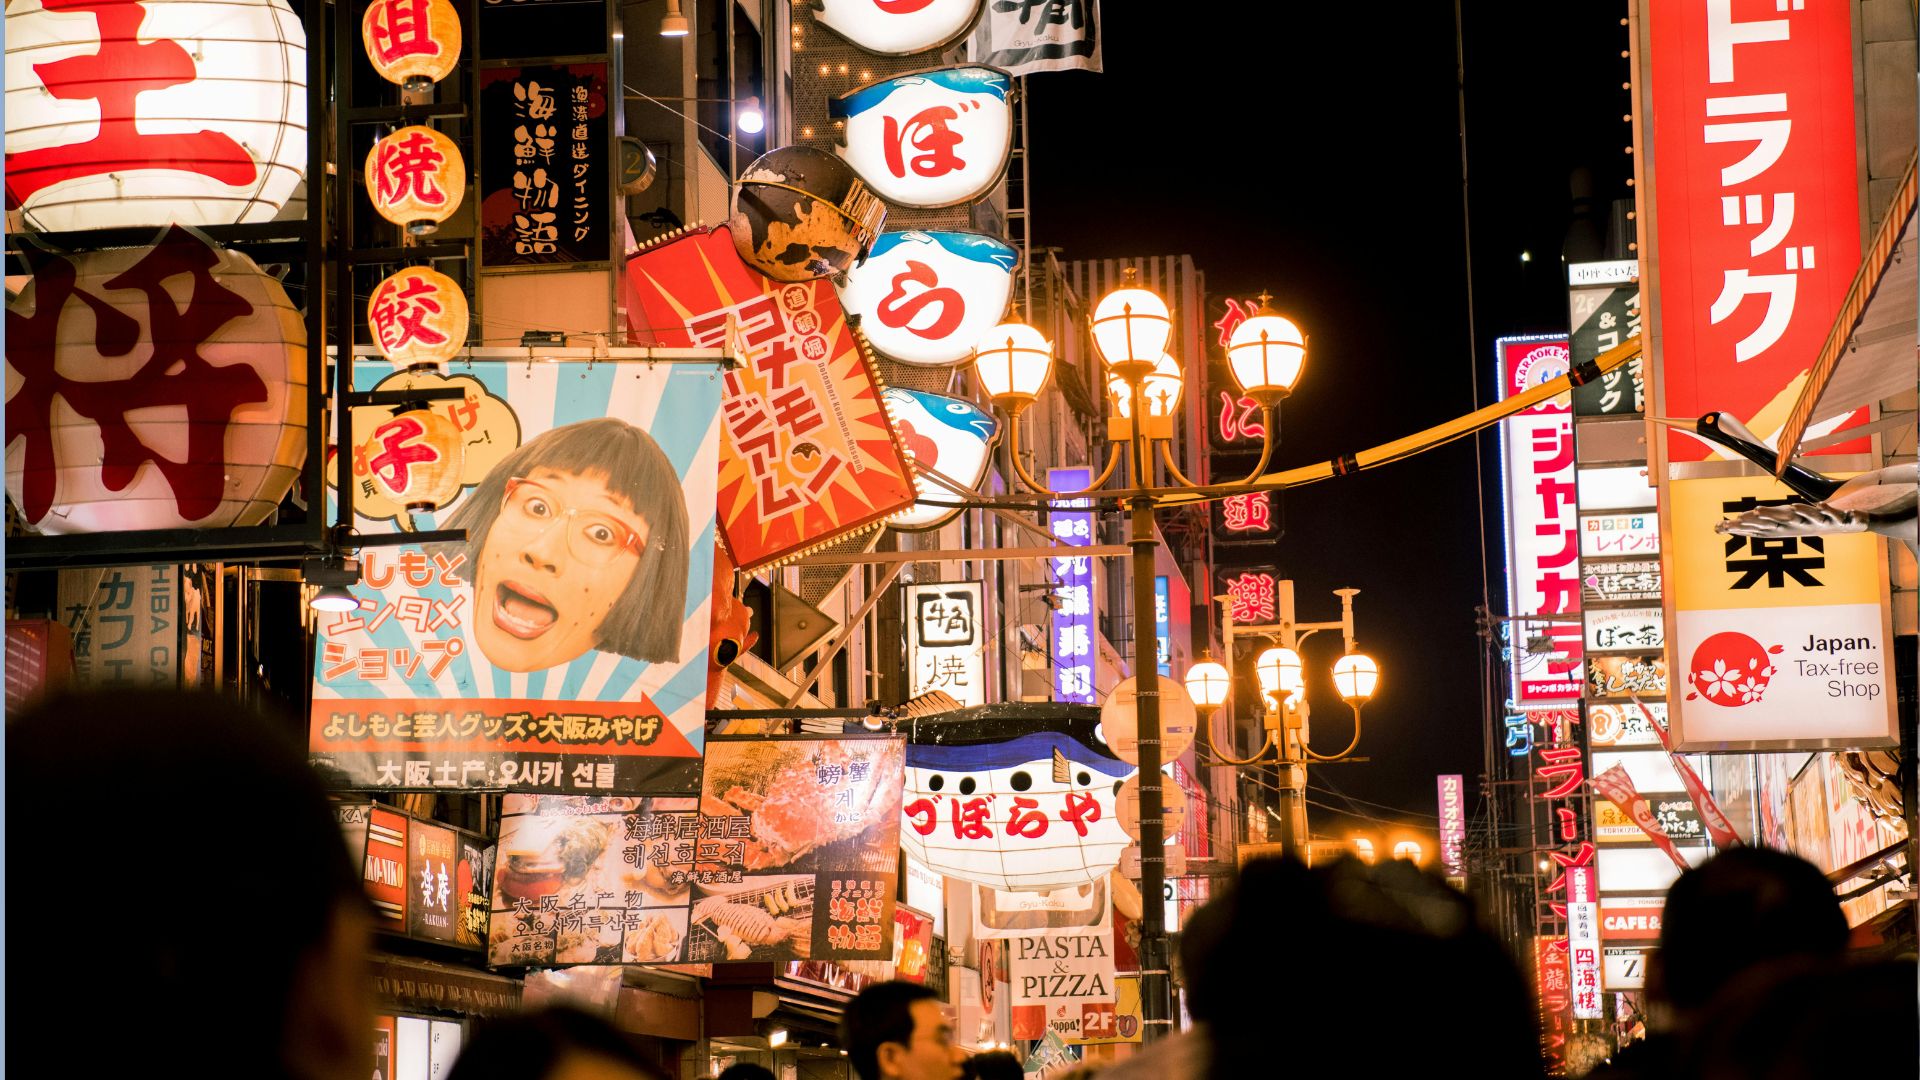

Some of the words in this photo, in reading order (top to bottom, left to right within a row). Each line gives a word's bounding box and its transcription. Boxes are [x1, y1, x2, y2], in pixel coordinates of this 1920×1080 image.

[513, 81, 559, 255] 海鮮物語
[358, 551, 468, 590] しもと
[1597, 624, 1664, 648] ぼて茶
[1802, 634, 1877, 655] Japan.
[322, 637, 465, 683] ショップ
[1794, 658, 1880, 677] Tax-free
[926, 655, 969, 700] 焼
[1827, 680, 1881, 701] Shop
[571, 761, 616, 788] 선물
[623, 815, 753, 841] 海鮮居酒屋
[903, 791, 1102, 840] づぼらや
[622, 842, 746, 870] 해선호프집
[1604, 916, 1648, 931] CAFE
[511, 939, 554, 953] 大阪名物
[1018, 935, 1109, 961] PASTA
[1052, 960, 1069, 974] &
[1021, 973, 1108, 999] PIZZA
[1084, 1011, 1113, 1031] 2F
